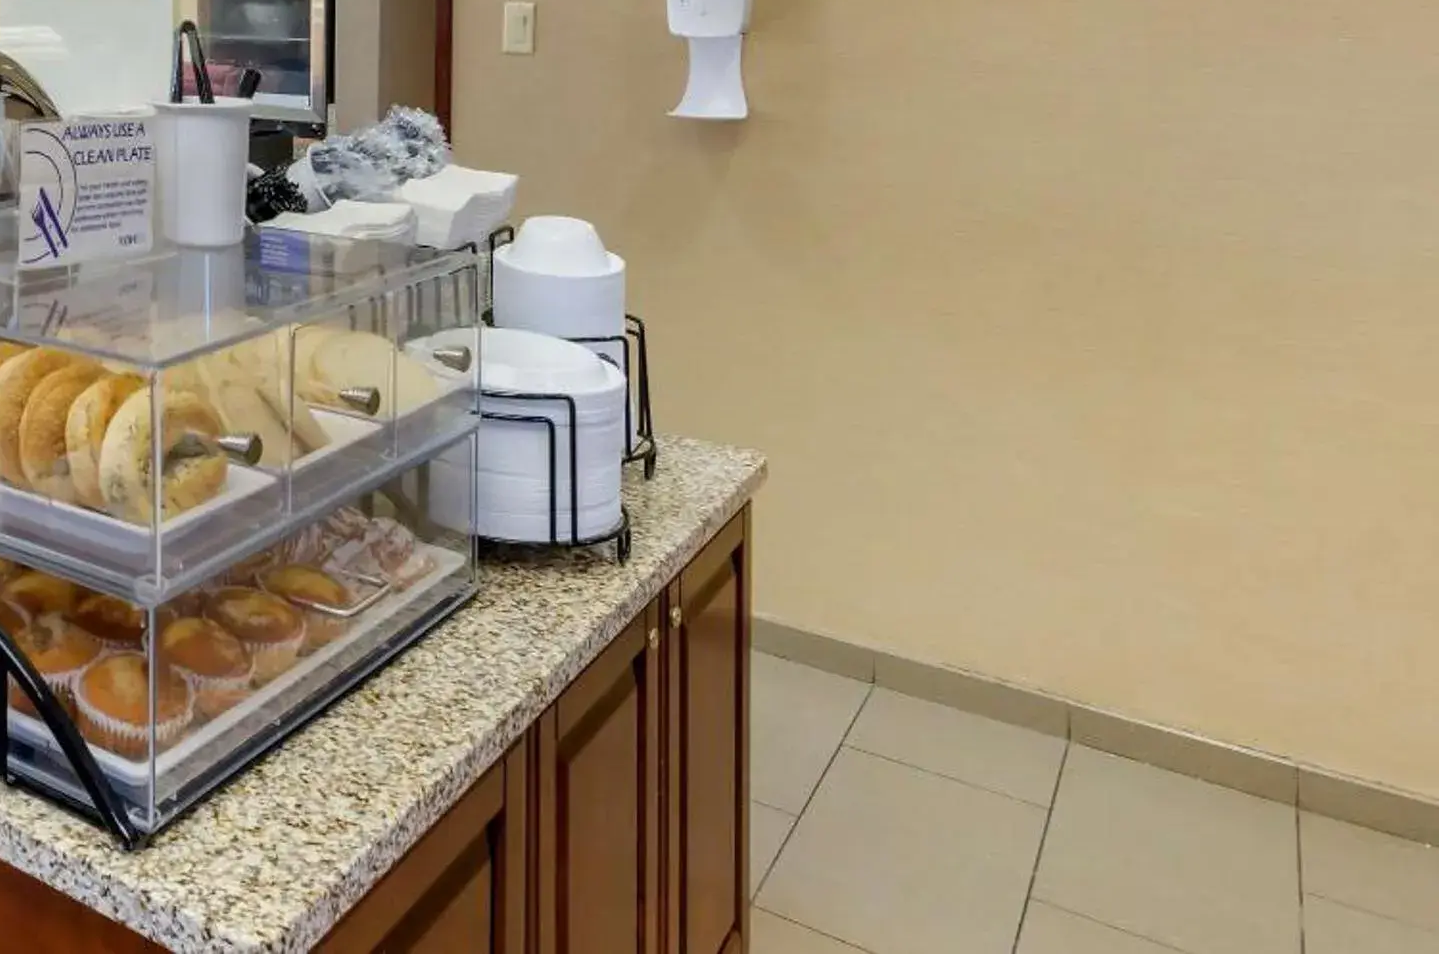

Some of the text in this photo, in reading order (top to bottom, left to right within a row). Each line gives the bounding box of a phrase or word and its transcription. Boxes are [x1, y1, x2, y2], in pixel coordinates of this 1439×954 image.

[62, 121, 147, 141] ALWAYS USE A
[73, 146, 153, 166] CLEAN PLATE
